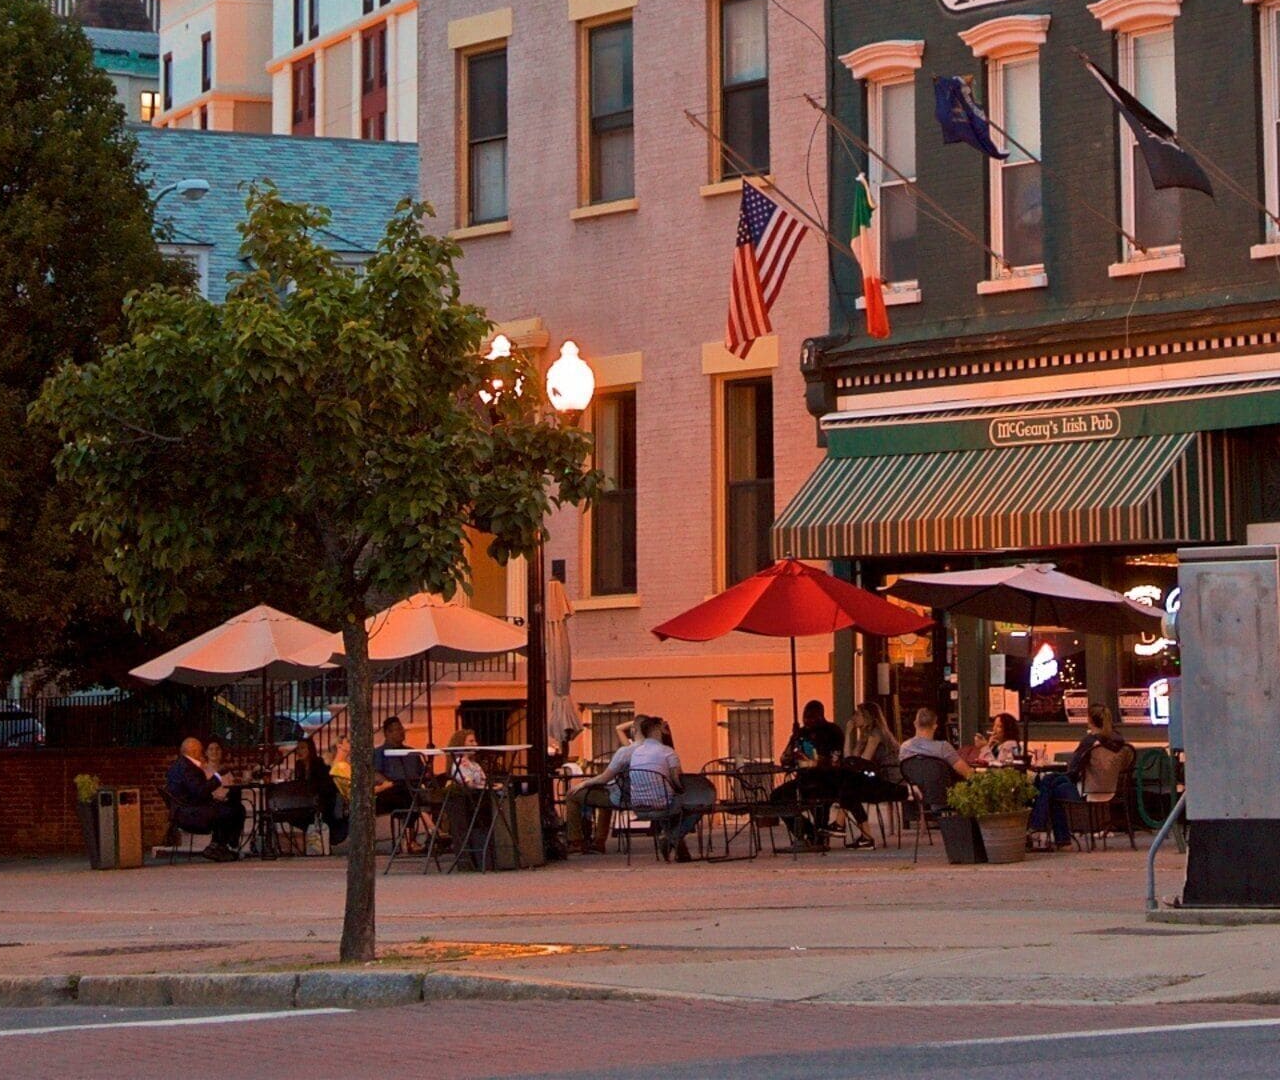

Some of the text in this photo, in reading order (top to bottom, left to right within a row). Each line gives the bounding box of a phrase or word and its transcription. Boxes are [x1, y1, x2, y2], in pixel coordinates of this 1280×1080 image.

[997, 414, 1113, 440] McGeary's Irish Pub
